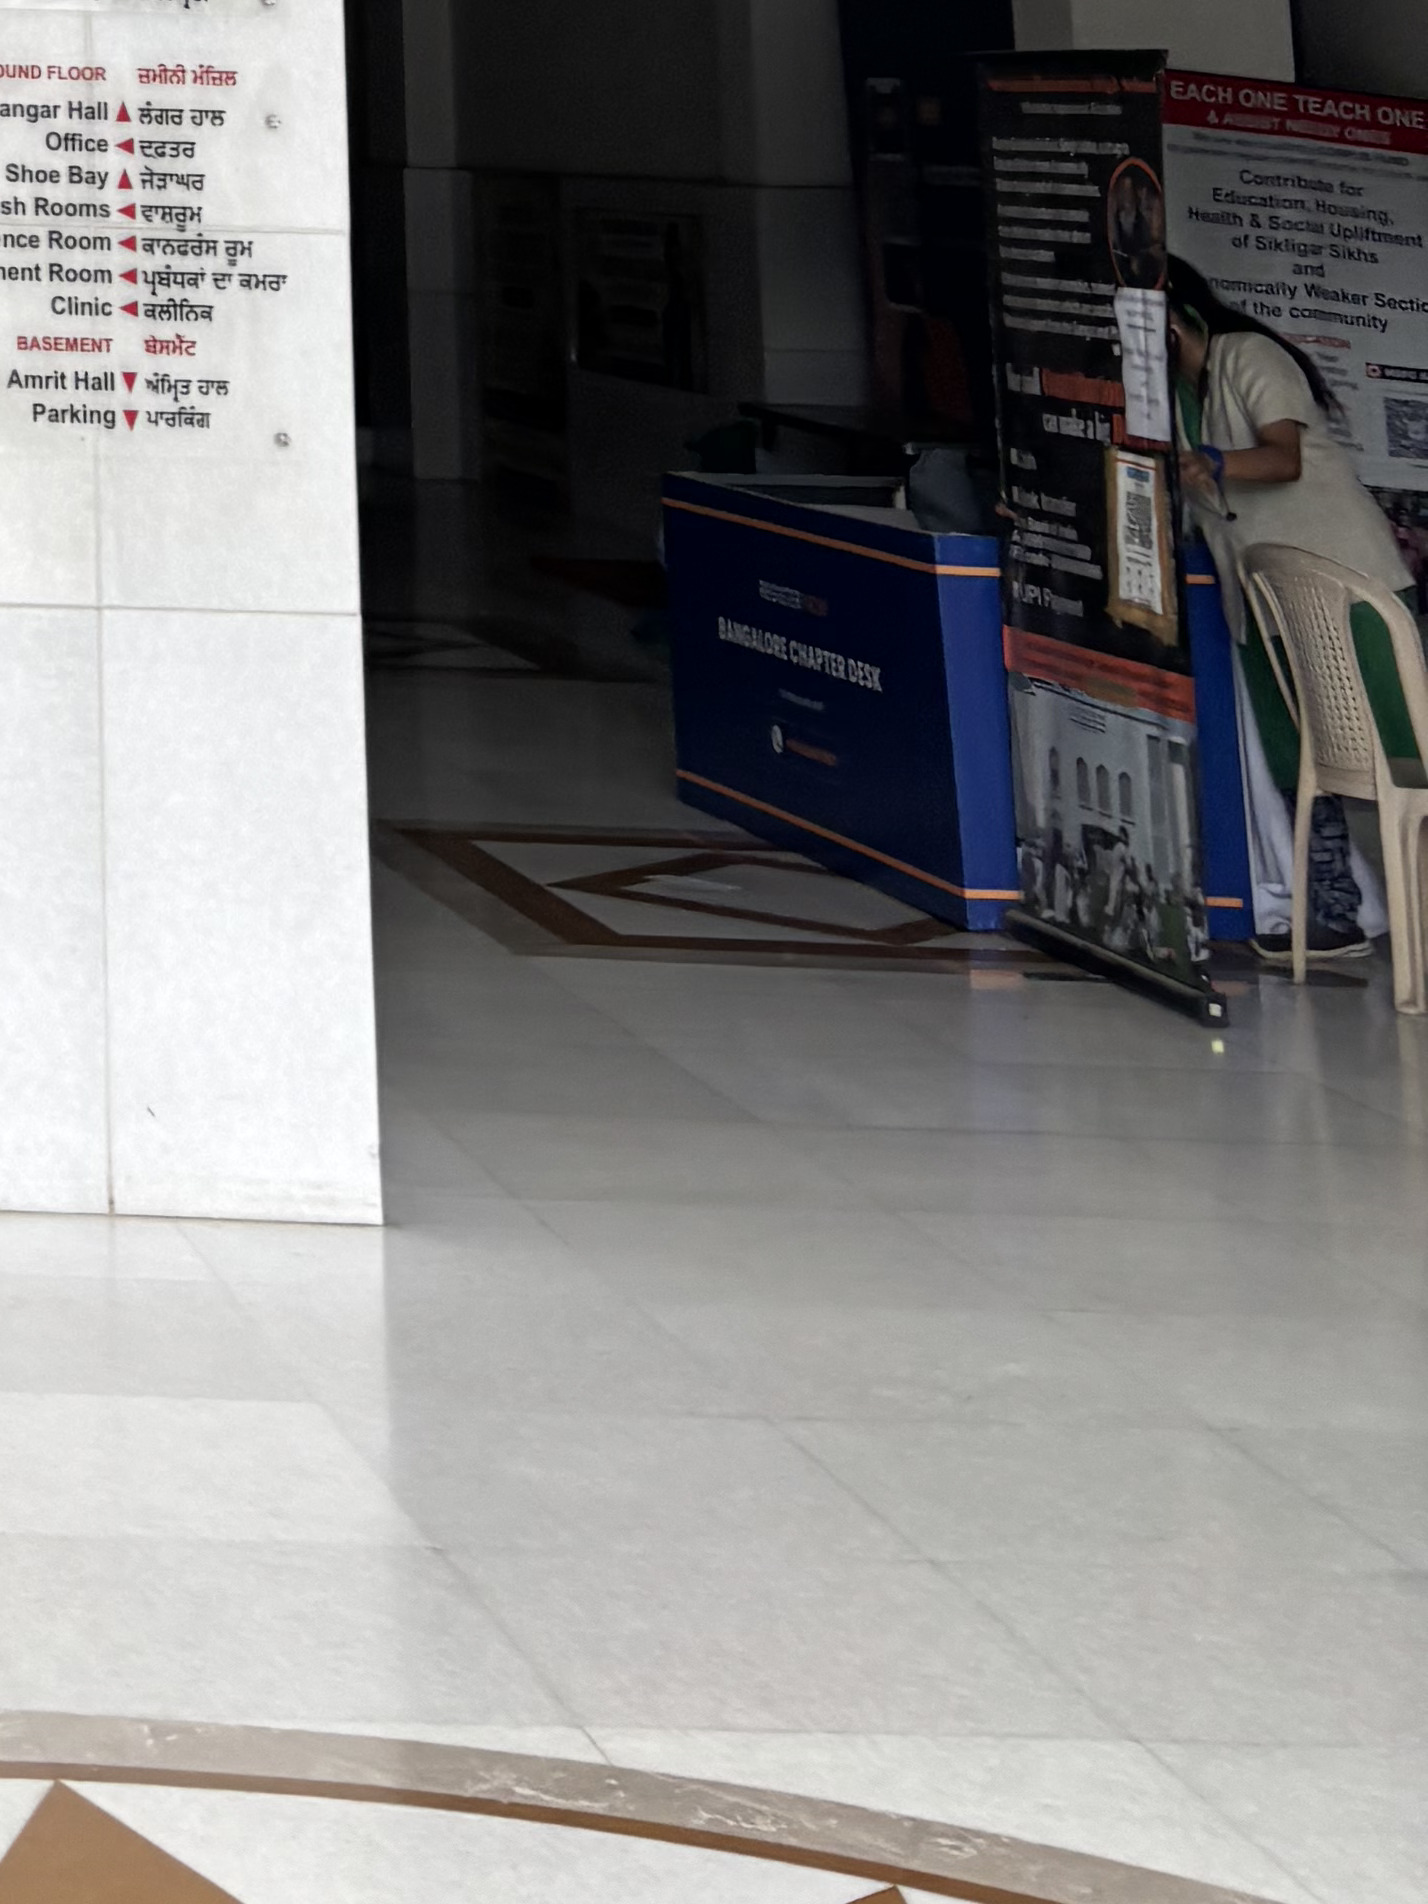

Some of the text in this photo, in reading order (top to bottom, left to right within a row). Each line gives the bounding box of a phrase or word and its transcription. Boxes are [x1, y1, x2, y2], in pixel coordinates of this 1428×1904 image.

[47, 66, 106, 81] FLOOR
[68, 101, 108, 120] Hall
[1170, 81, 1233, 105] EACH
[1239, 88, 1289, 111] ONE
[1293, 94, 1371, 122] TEACH
[1377, 105, 1424, 129] ONE
[46, 132, 108, 152] Office
[6, 163, 108, 190] Shoe Bay
[1239, 170, 1364, 197] Contribute for
[34, 197, 110, 218] Rooms
[1314, 199, 1394, 225] Housing,
[1188, 206, 1423, 248] Health & Social Upliftment
[48, 230, 111, 251] Room
[1232, 235, 1248, 249] of
[1329, 245, 1379, 264] Sikhs
[49, 263, 112, 284] Room
[1292, 262, 1326, 278] and
[1210, 278, 1297, 298] nomically
[1304, 283, 1369, 307] Weaker
[51, 296, 112, 316] Clinic
[1253, 301, 1283, 318] the
[1289, 305, 1388, 333] community
[17, 336, 113, 353] BASEMENT
[7, 369, 115, 391] Amrit Hall
[33, 403, 116, 429] Parking
[717, 616, 883, 692] BANGALORE CHAPTER DESK
